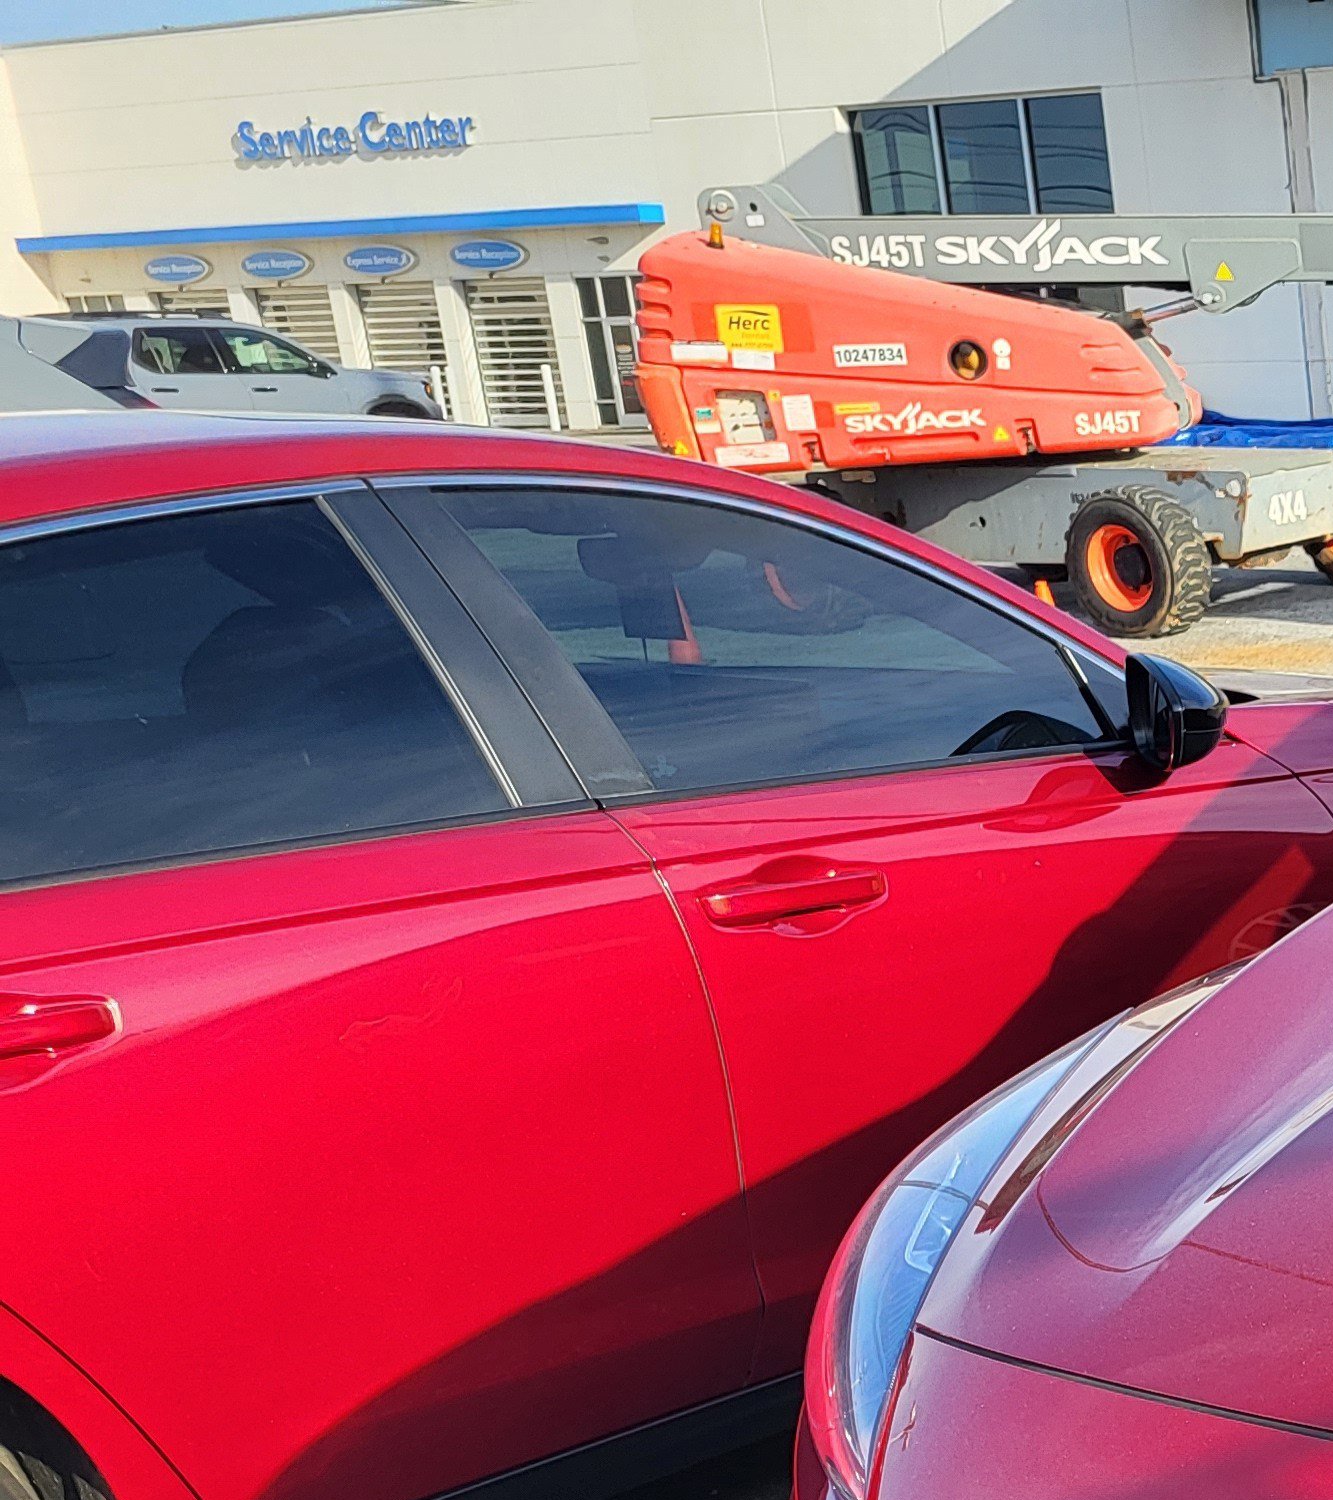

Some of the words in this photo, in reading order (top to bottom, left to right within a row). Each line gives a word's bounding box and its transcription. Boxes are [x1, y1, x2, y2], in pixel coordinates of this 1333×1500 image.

[237, 116, 350, 160] Service
[358, 111, 474, 151] Center
[830, 235, 926, 268] SJ45T
[935, 218, 1170, 272] SKYJACK
[728, 316, 770, 331] Herc
[835, 347, 904, 364] 10247834
[845, 401, 986, 435] SKYJACK
[1075, 410, 1141, 436] SJ45T
